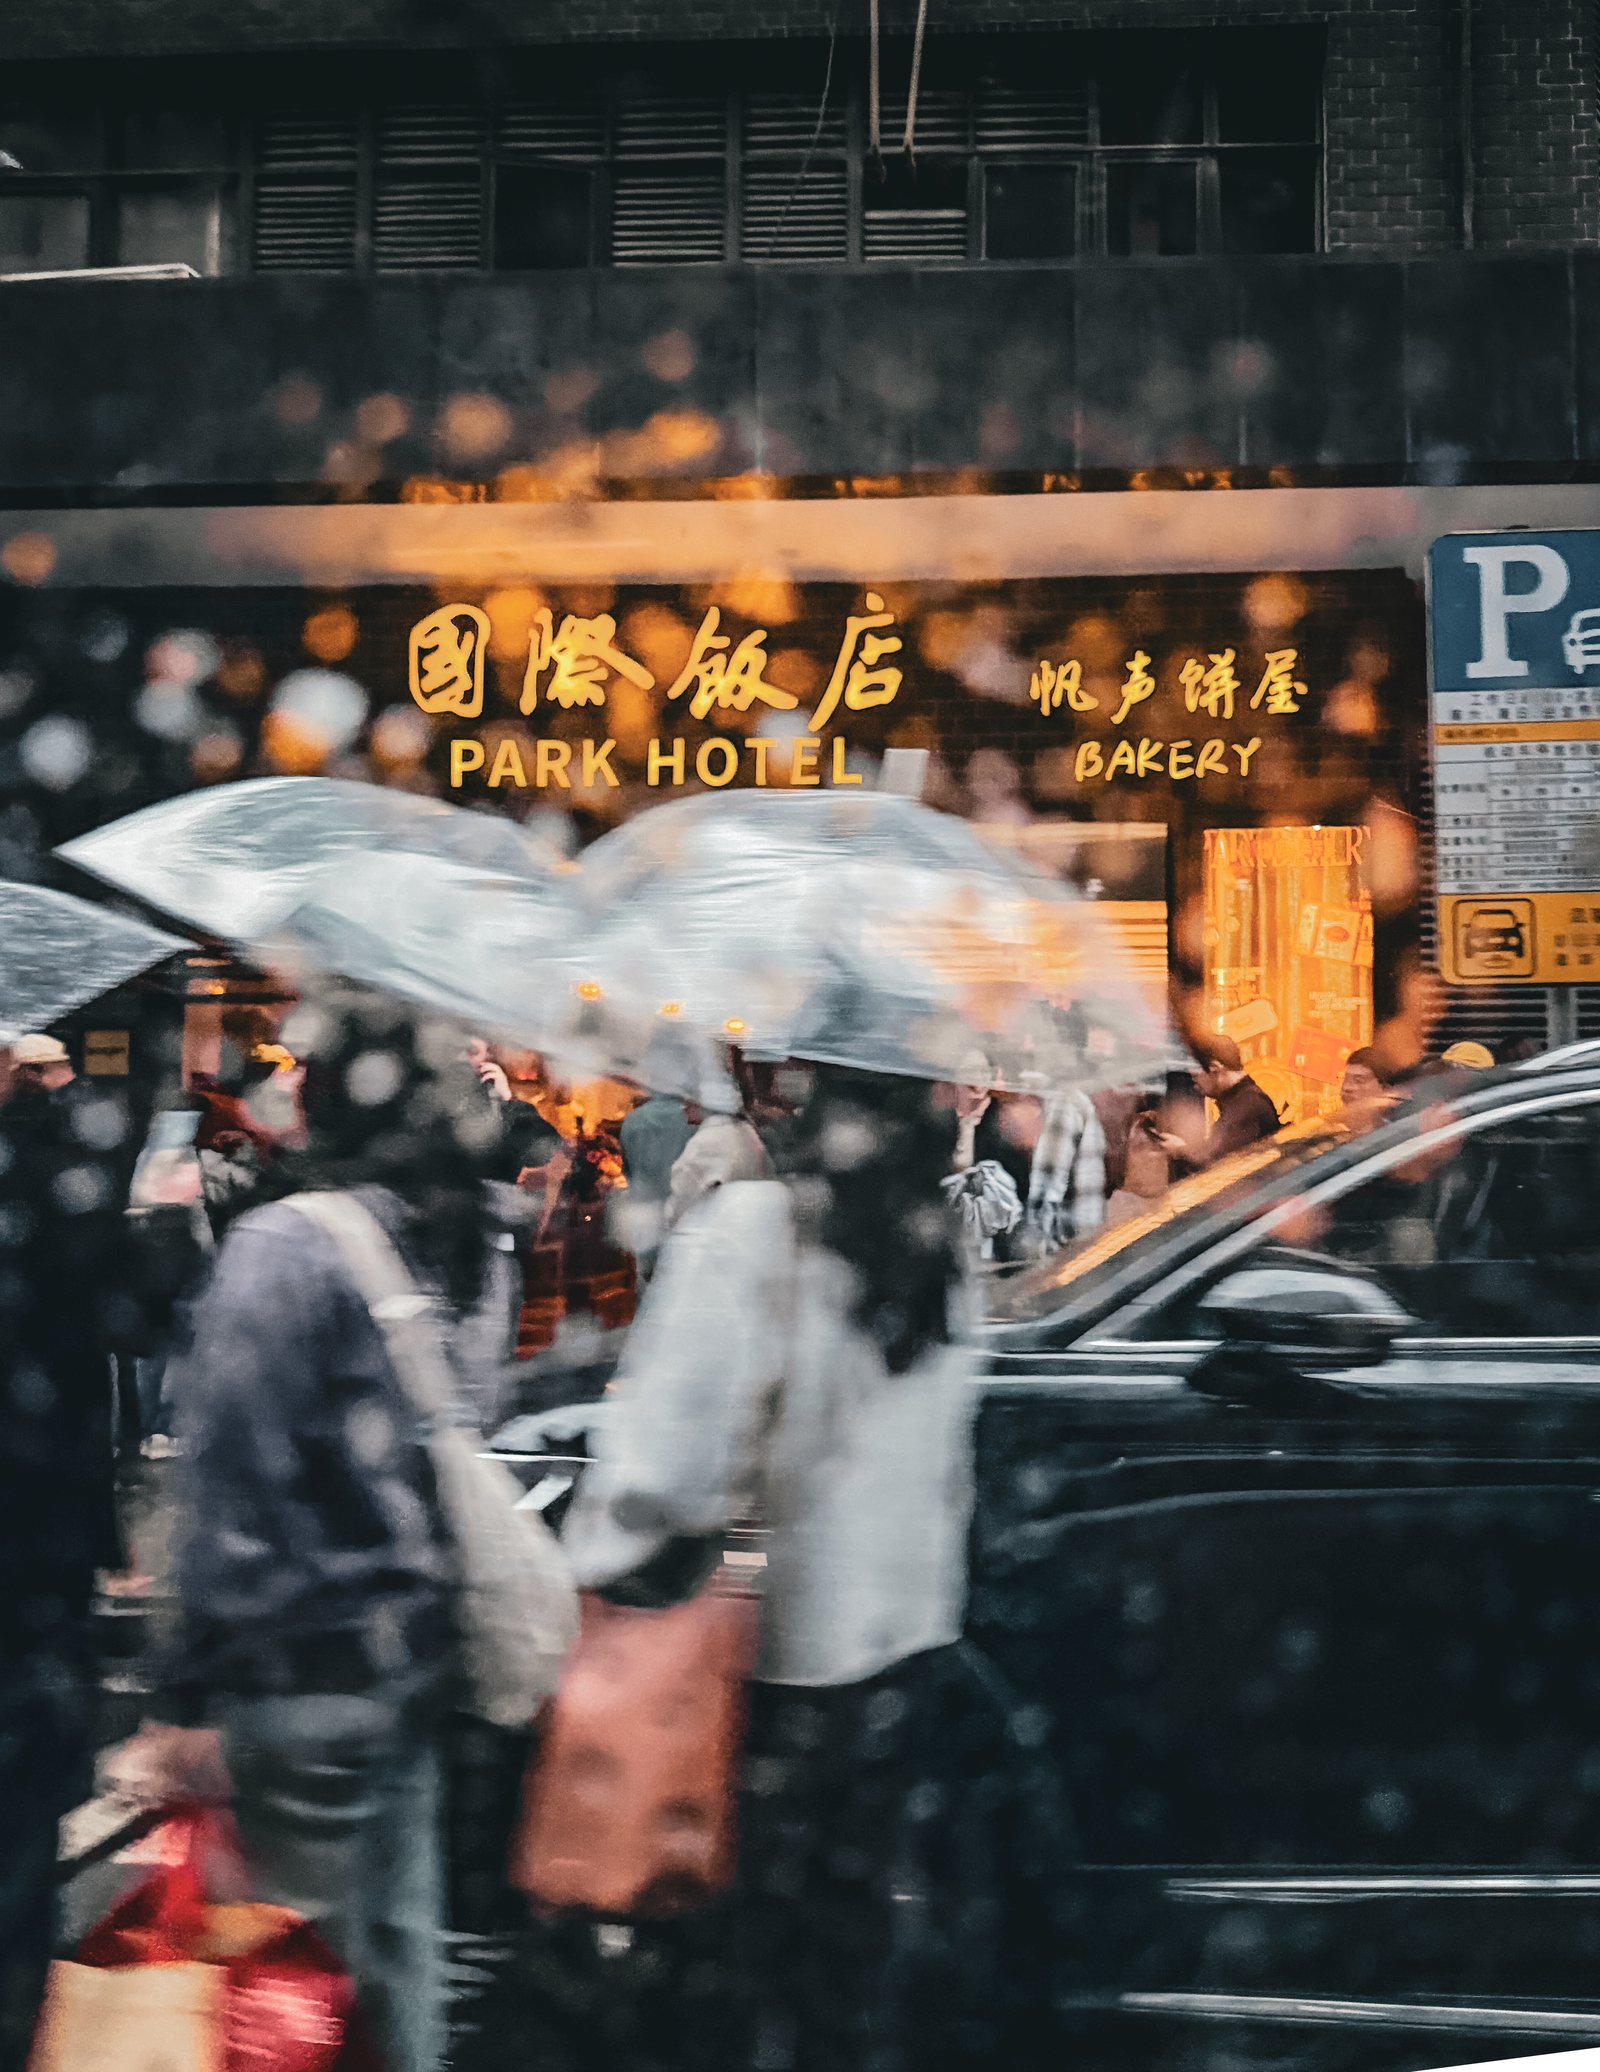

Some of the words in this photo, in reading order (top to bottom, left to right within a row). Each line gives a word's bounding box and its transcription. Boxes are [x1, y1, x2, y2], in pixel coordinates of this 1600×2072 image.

[1462, 544, 1571, 678] P
[449, 738, 620, 788] PARK
[647, 736, 863, 788] HOTEL
[1074, 737, 1262, 782] BAKERY
